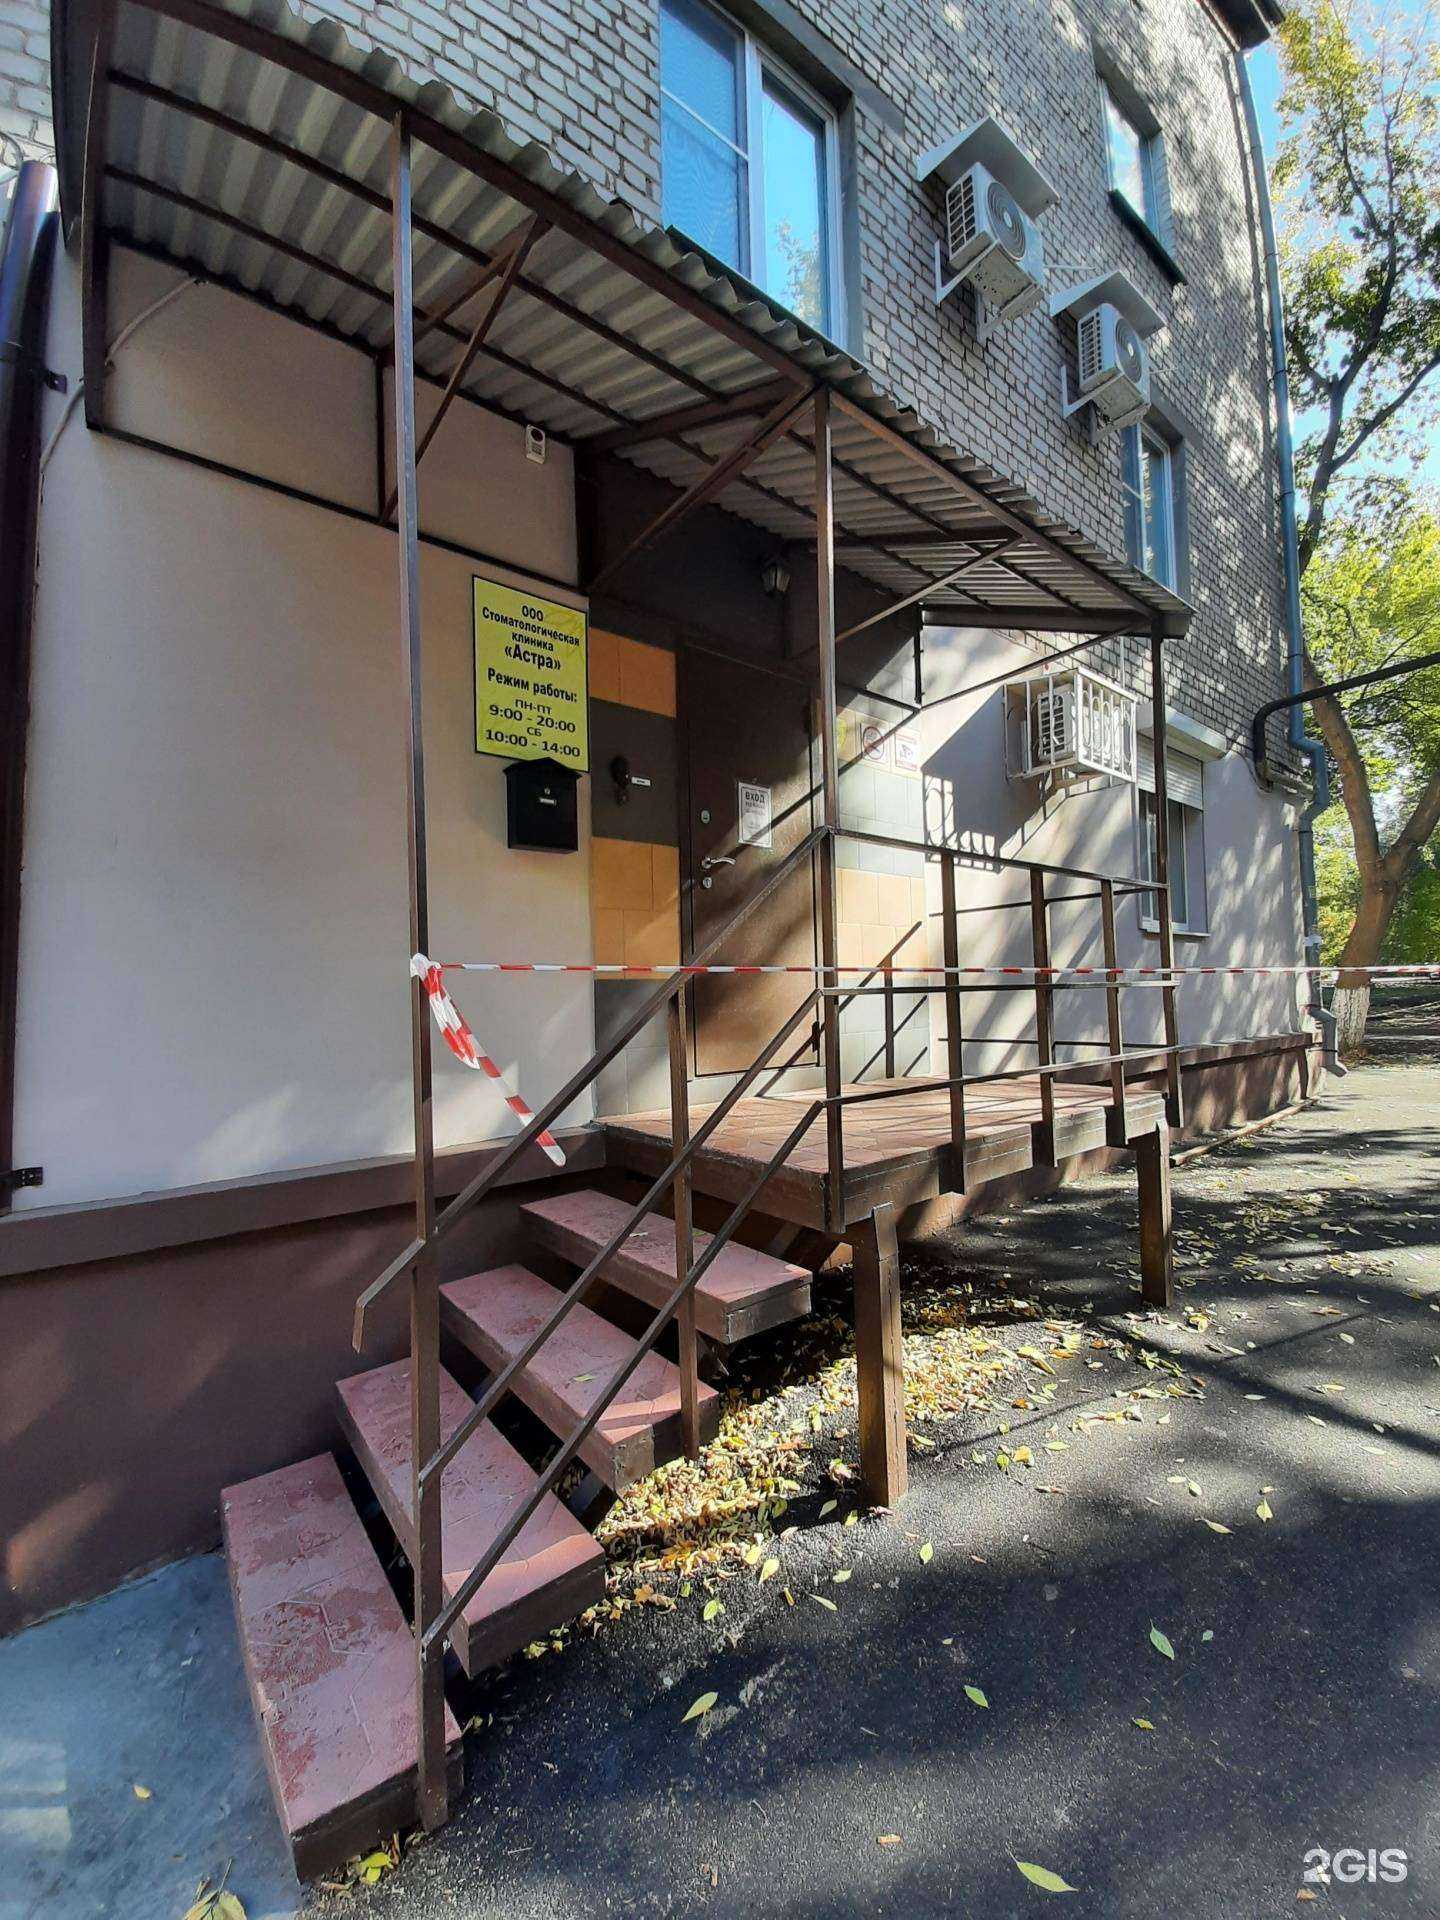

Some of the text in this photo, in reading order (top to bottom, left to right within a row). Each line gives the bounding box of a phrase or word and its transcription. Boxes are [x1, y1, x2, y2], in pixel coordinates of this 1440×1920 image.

[482, 606, 580, 647] Стоматологическая
[521, 605, 544, 622] ООО
[512, 632, 554, 652] клиника
[504, 644, 561, 671] «Астра»
[487, 667, 578, 703] Режим работы:
[489, 704, 523, 722] 9:00
[536, 715, 576, 733] 20:00
[514, 698, 552, 715] ПН-ПТ
[485, 729, 528, 748] 10:00
[541, 741, 581, 758] 14:00
[526, 726, 543, 738] СБ
